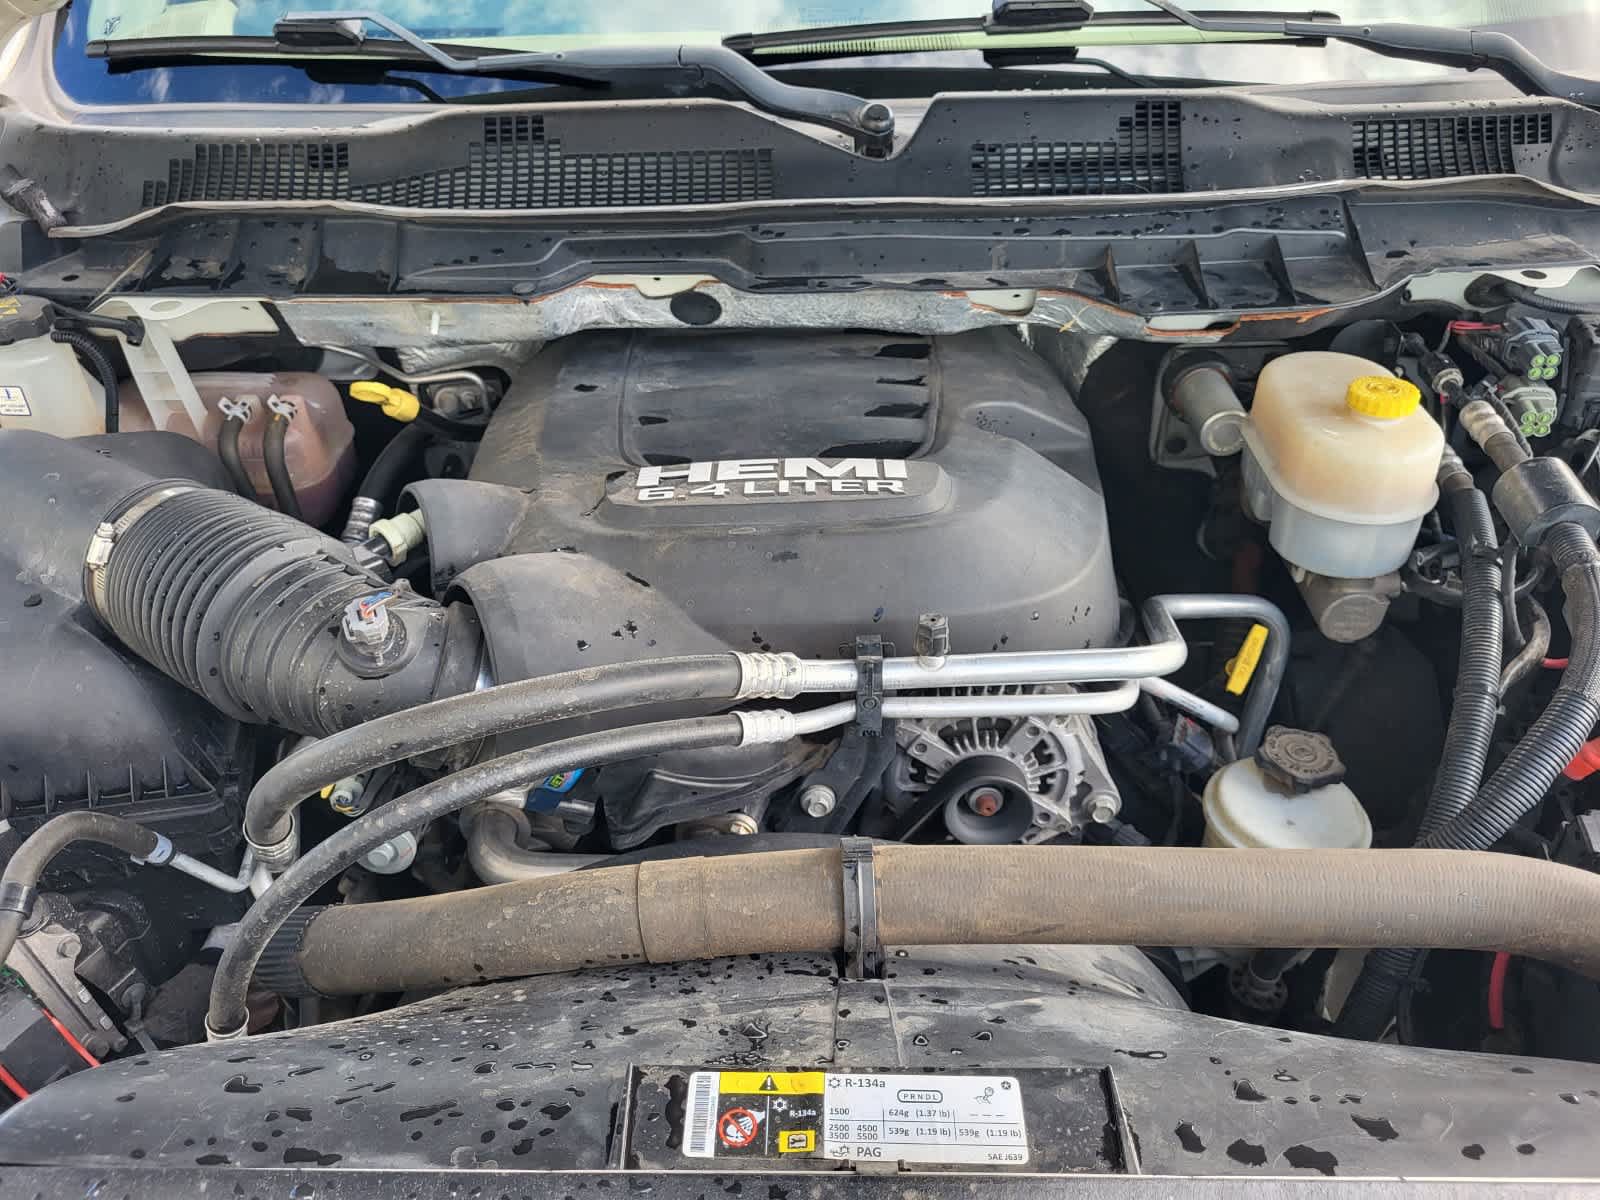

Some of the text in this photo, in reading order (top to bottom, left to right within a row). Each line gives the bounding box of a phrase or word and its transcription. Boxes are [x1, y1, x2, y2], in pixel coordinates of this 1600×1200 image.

[636, 457, 908, 487] HEMI
[638, 479, 905, 501] 6.4 LITER
[845, 1078, 886, 1088] R-134a
[829, 1108, 850, 1116] 1500
[888, 1108, 951, 1118] 624g (1.37 lb)
[829, 1124, 850, 1132] 2500
[888, 1127, 951, 1137] 539g (1.19 lb)
[959, 1128, 1022, 1138] 539g (1.19 lb)
[829, 1132, 878, 1140] 3500 5500
[856, 1146, 882, 1157] PAG
